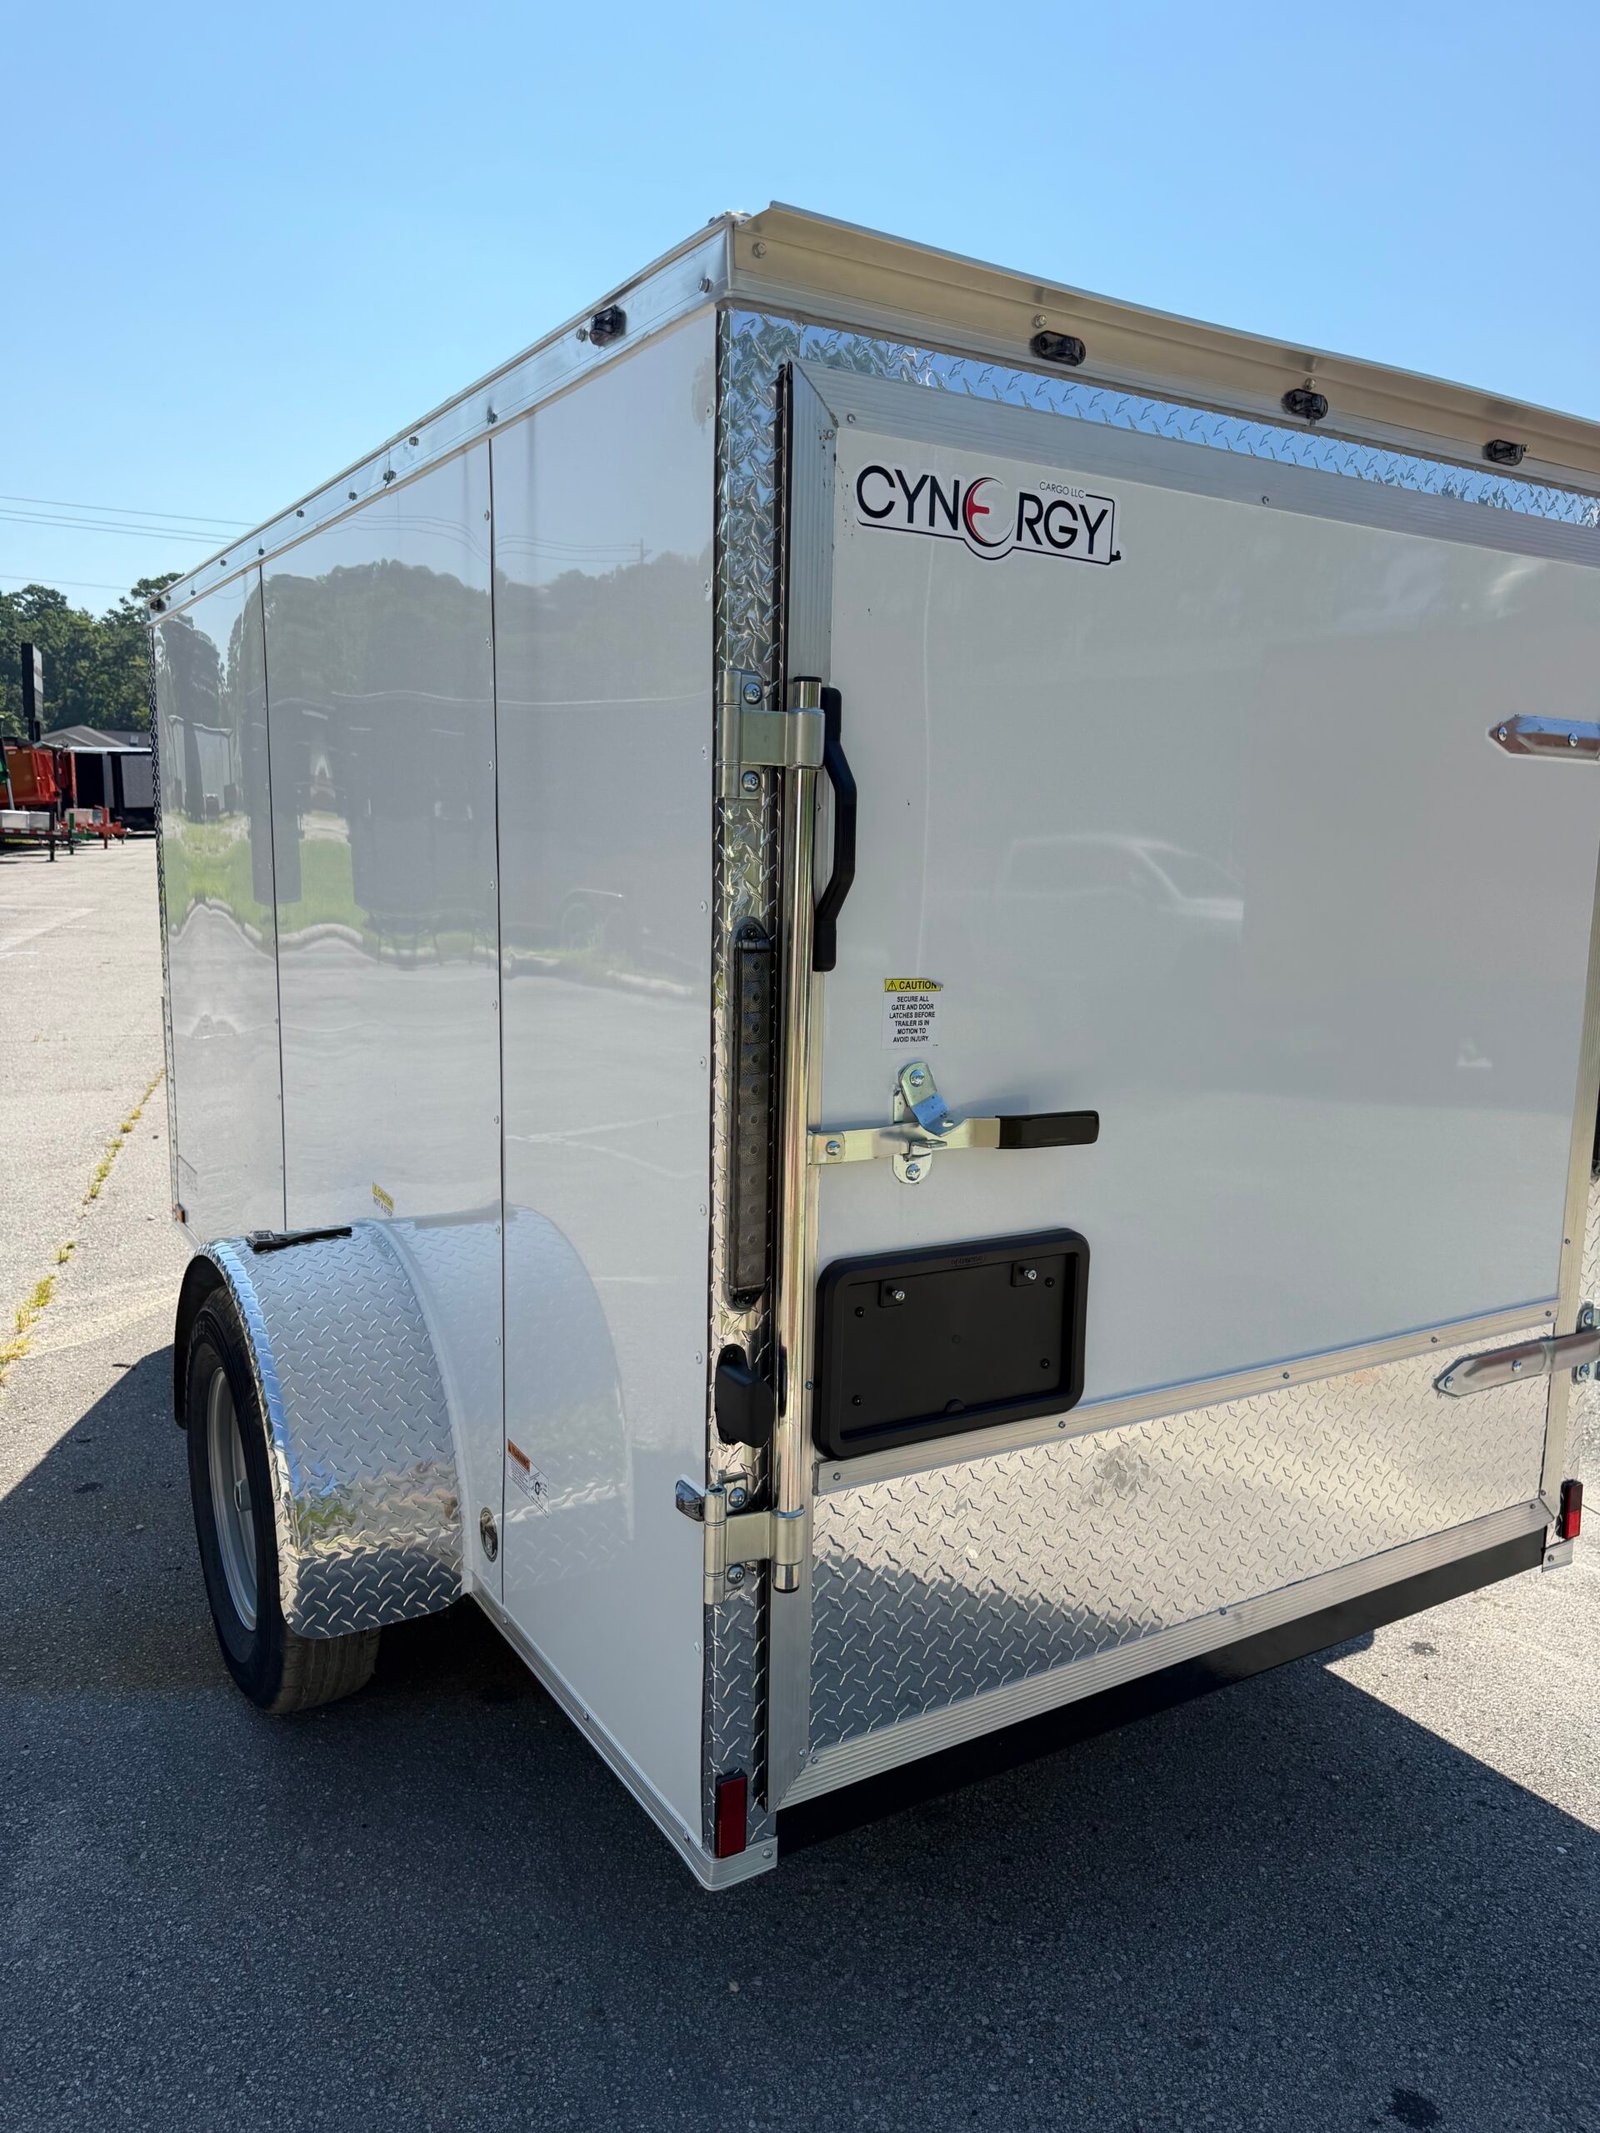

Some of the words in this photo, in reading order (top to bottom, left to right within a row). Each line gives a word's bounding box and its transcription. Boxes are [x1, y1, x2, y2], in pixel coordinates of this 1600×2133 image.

[1039, 481, 1070, 495] CARGO
[1071, 488, 1085, 499] LLC
[856, 465, 1109, 555] CYNERGY
[898, 981, 937, 990] CAUTION
